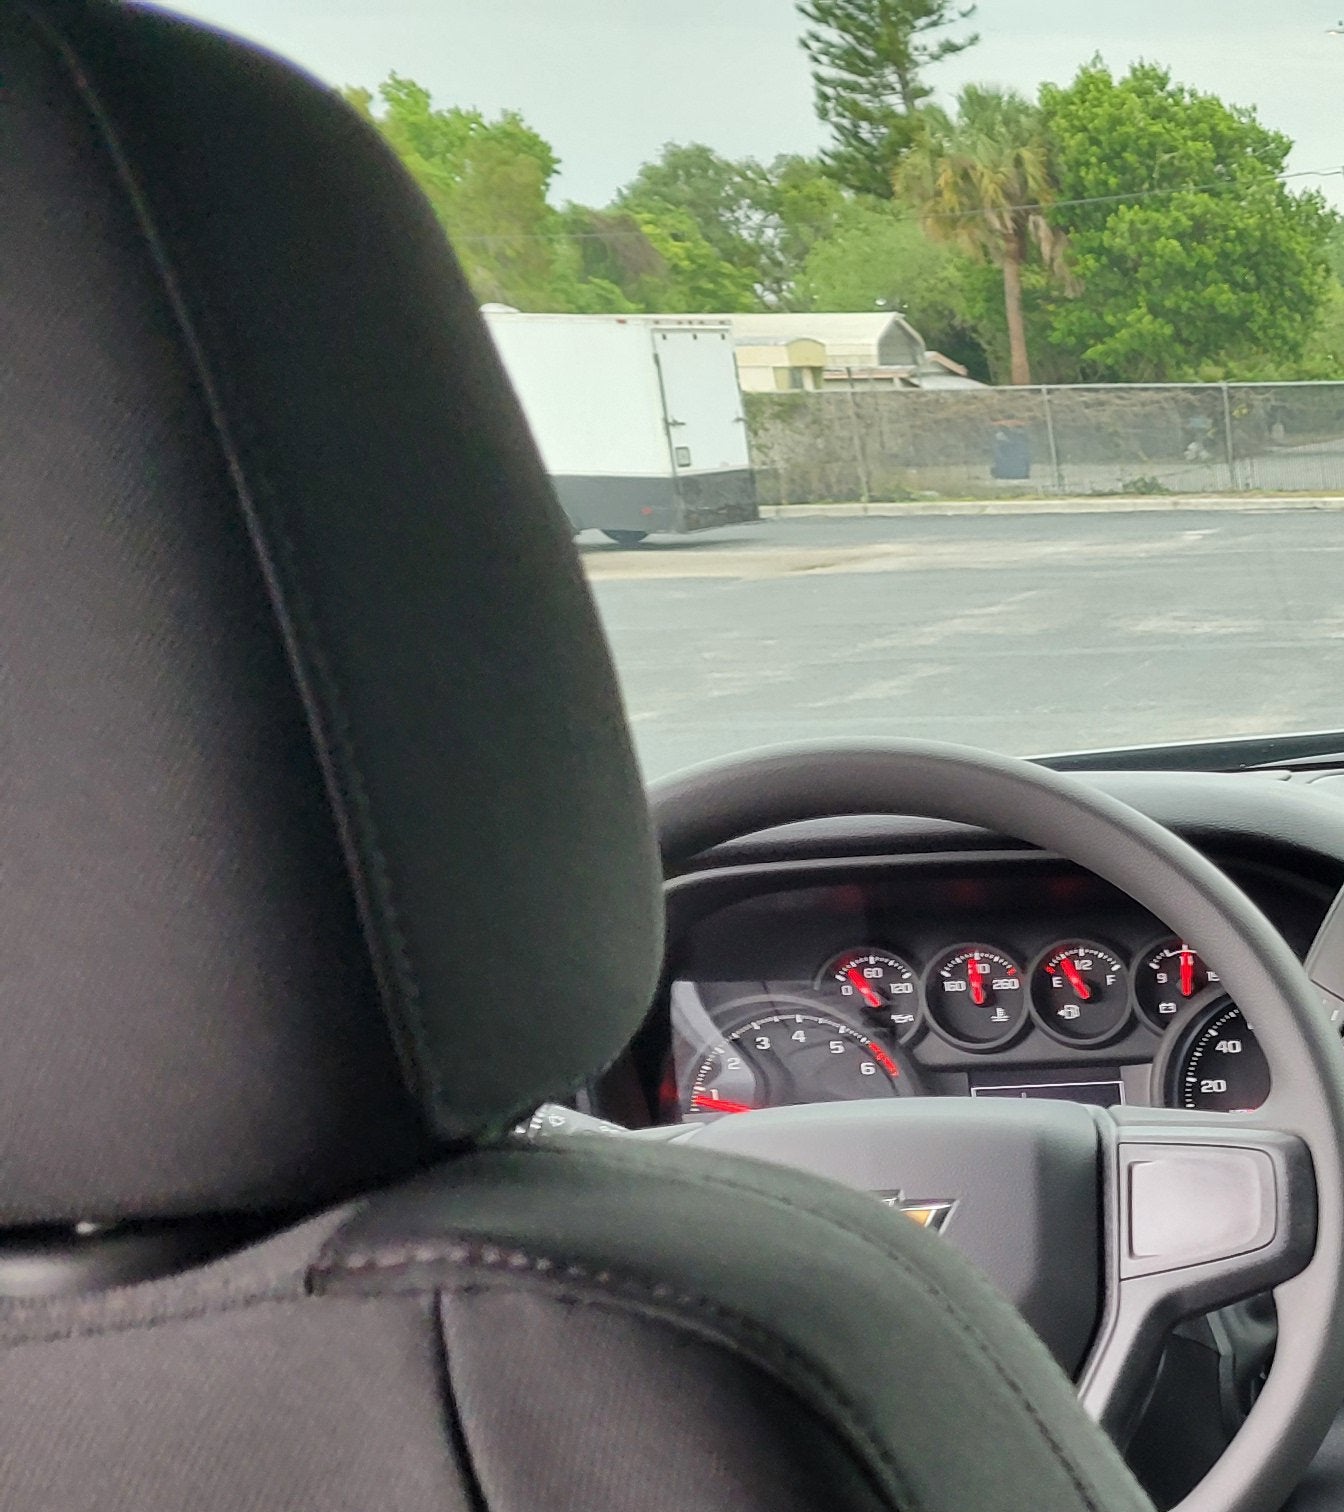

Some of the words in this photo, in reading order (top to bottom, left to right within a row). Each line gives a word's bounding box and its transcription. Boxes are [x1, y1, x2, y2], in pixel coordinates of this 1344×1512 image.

[863, 967, 883, 979] 60
[943, 980, 967, 992] 160
[992, 977, 1020, 990] 260
[1052, 976, 1064, 988] E
[1105, 974, 1117, 986] F
[841, 985, 853, 996] 0
[889, 982, 914, 994] 120
[792, 1030, 806, 1043] 4
[755, 1037, 771, 1050] 3
[829, 1041, 845, 1054] 5
[1214, 1040, 1242, 1054] 40
[727, 1057, 741, 1070] 2
[860, 1062, 876, 1075] 6
[1200, 1079, 1227, 1093] 20
